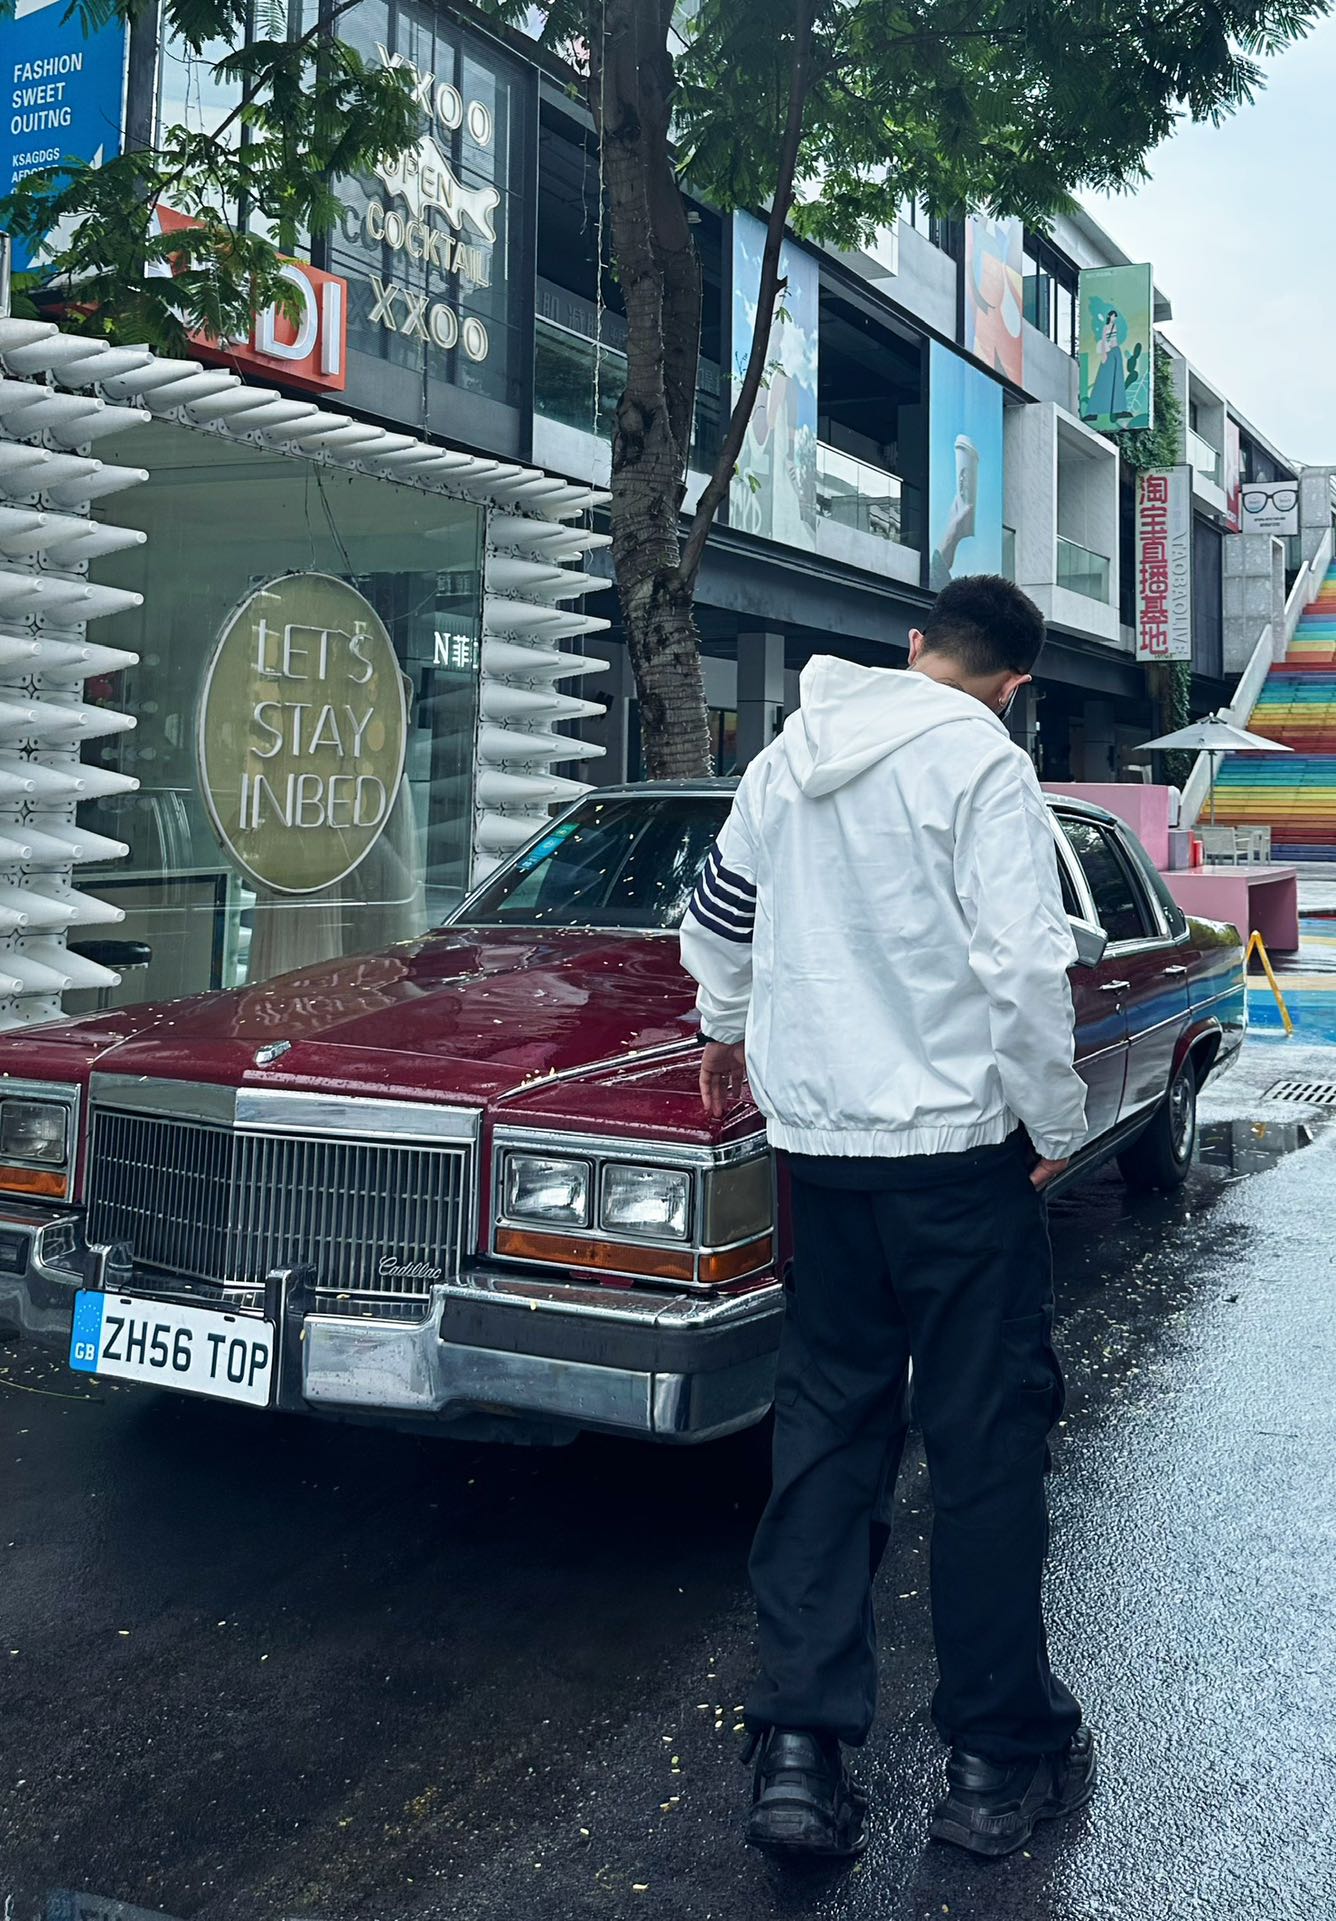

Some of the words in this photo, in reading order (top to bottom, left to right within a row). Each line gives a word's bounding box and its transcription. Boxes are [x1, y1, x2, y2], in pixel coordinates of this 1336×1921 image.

[13, 52, 83, 84] FASHION
[12, 81, 66, 109] SWEET
[10, 106, 72, 135] OUITNG
[12, 147, 60, 168] KSAGDGS
[382, 148, 454, 209] OPEN
[366, 201, 492, 289] COCKTAIL
[368, 273, 489, 363] XXOO
[1139, 474, 1169, 655] 淘宝直播基地
[250, 701, 375, 758] STAY
[378, 1254, 442, 1279] Cadillac
[74, 1342, 96, 1361] GB
[102, 1315, 193, 1373] ZH56
[207, 1332, 269, 1387] TOP
